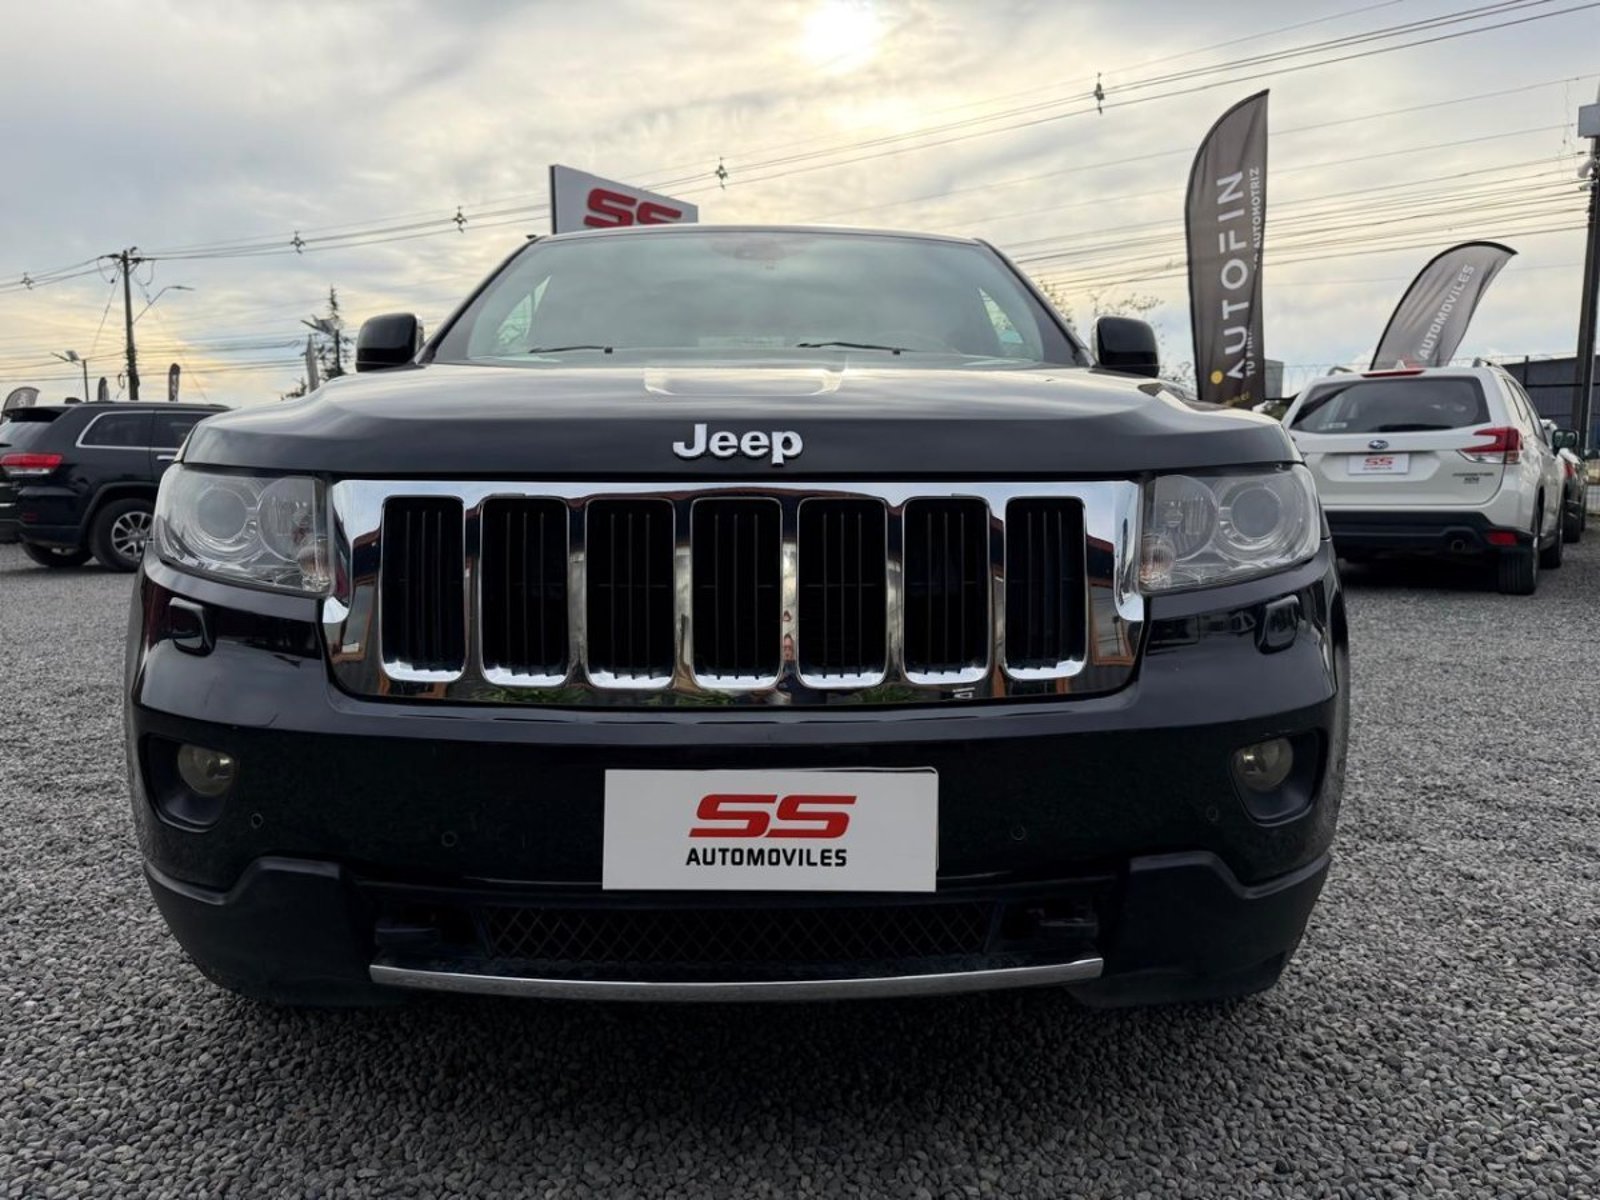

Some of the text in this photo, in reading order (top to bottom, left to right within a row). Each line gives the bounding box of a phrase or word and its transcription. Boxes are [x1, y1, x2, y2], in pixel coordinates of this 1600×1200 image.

[1249, 166, 1262, 249] AUTOMOTRIZ
[1215, 171, 1249, 379] AUTOFIN
[1419, 264, 1475, 360] AUTOMOVILES
[672, 423, 803, 465] Jeep
[688, 794, 857, 838] SS
[685, 847, 847, 867] AUTOMOVILES
